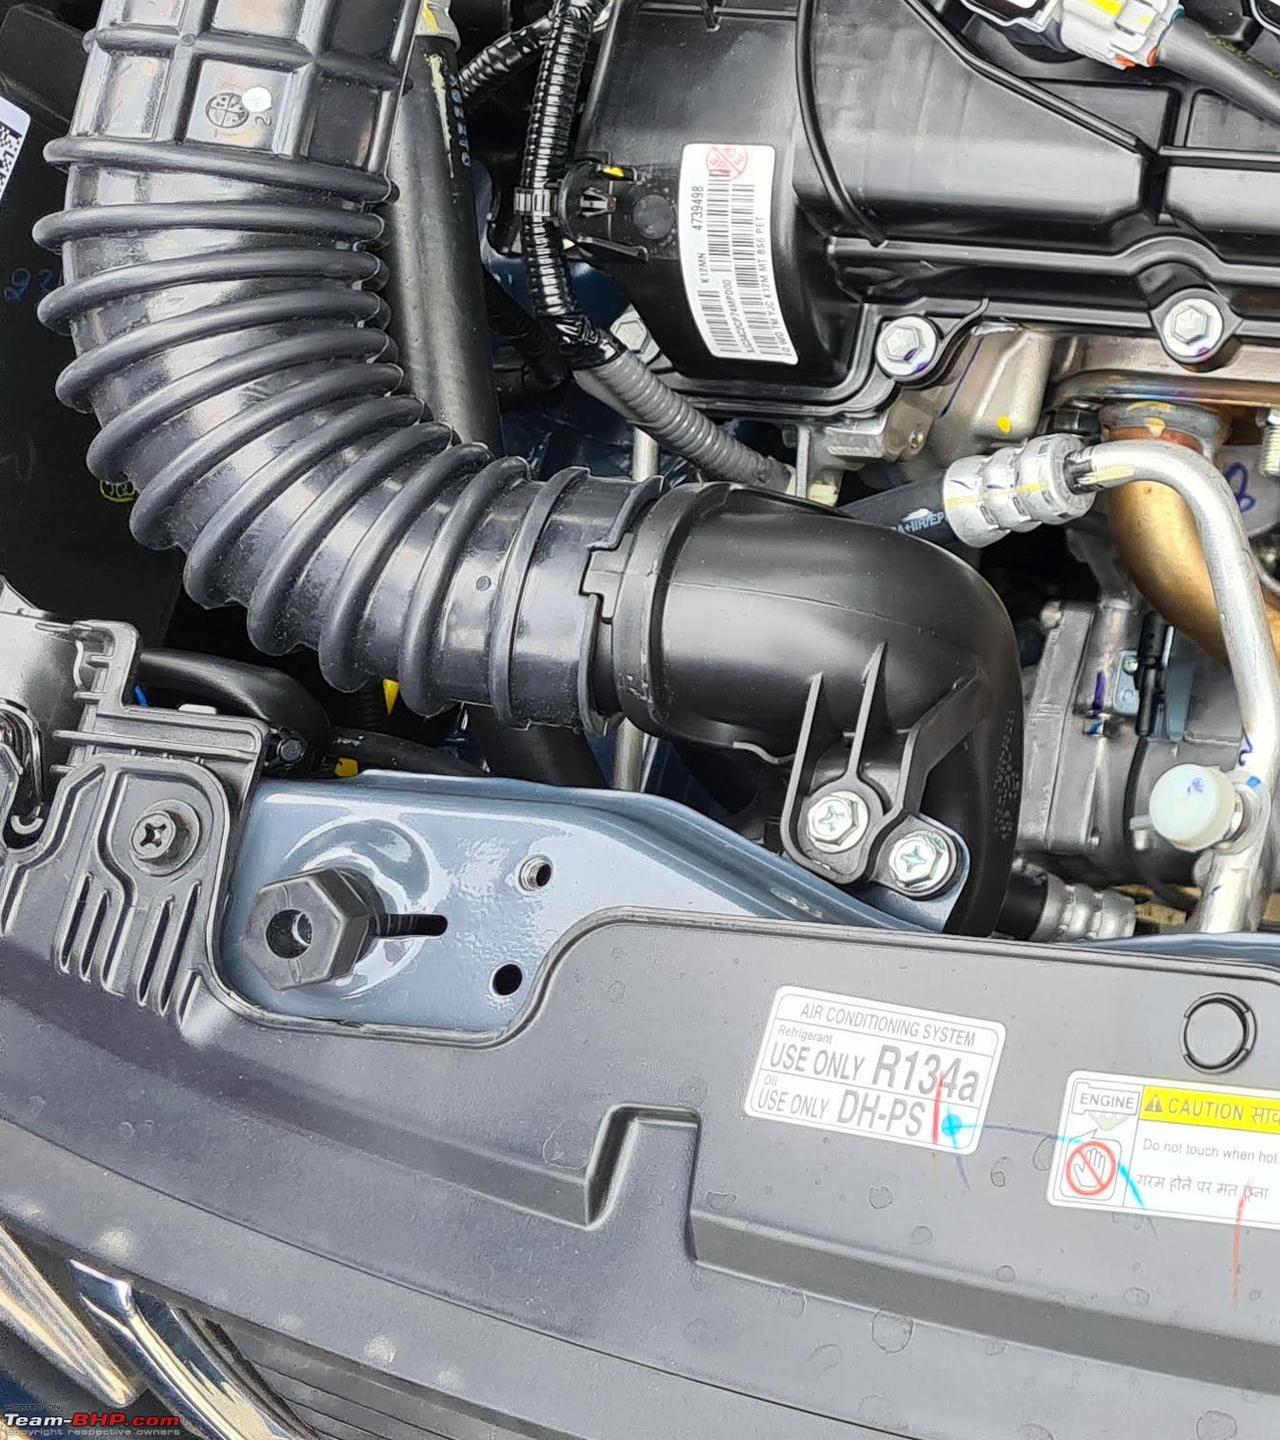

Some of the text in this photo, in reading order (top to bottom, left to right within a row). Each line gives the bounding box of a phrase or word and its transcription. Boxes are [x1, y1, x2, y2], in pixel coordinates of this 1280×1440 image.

[691, 185, 704, 230] 4739498
[755, 216, 766, 234] PET
[777, 1023, 833, 1045] Refrigerant
[800, 1002, 976, 1048] AIR CONDITIONING SYSTEM
[769, 1041, 981, 1103] USE ONLY R134a
[757, 1087, 927, 1137] USE ONLY DH-PS
[1079, 1092, 1135, 1110] ENGINE
[1168, 1097, 1243, 1121] CAUTION
[1143, 1137, 1280, 1165] Do not touch when hot.
[1137, 1173, 1164, 1188] गरम
[1169, 1174, 1193, 1194] होने
[1197, 1179, 1212, 1194] पर
[1216, 1182, 1237, 1198] मत
